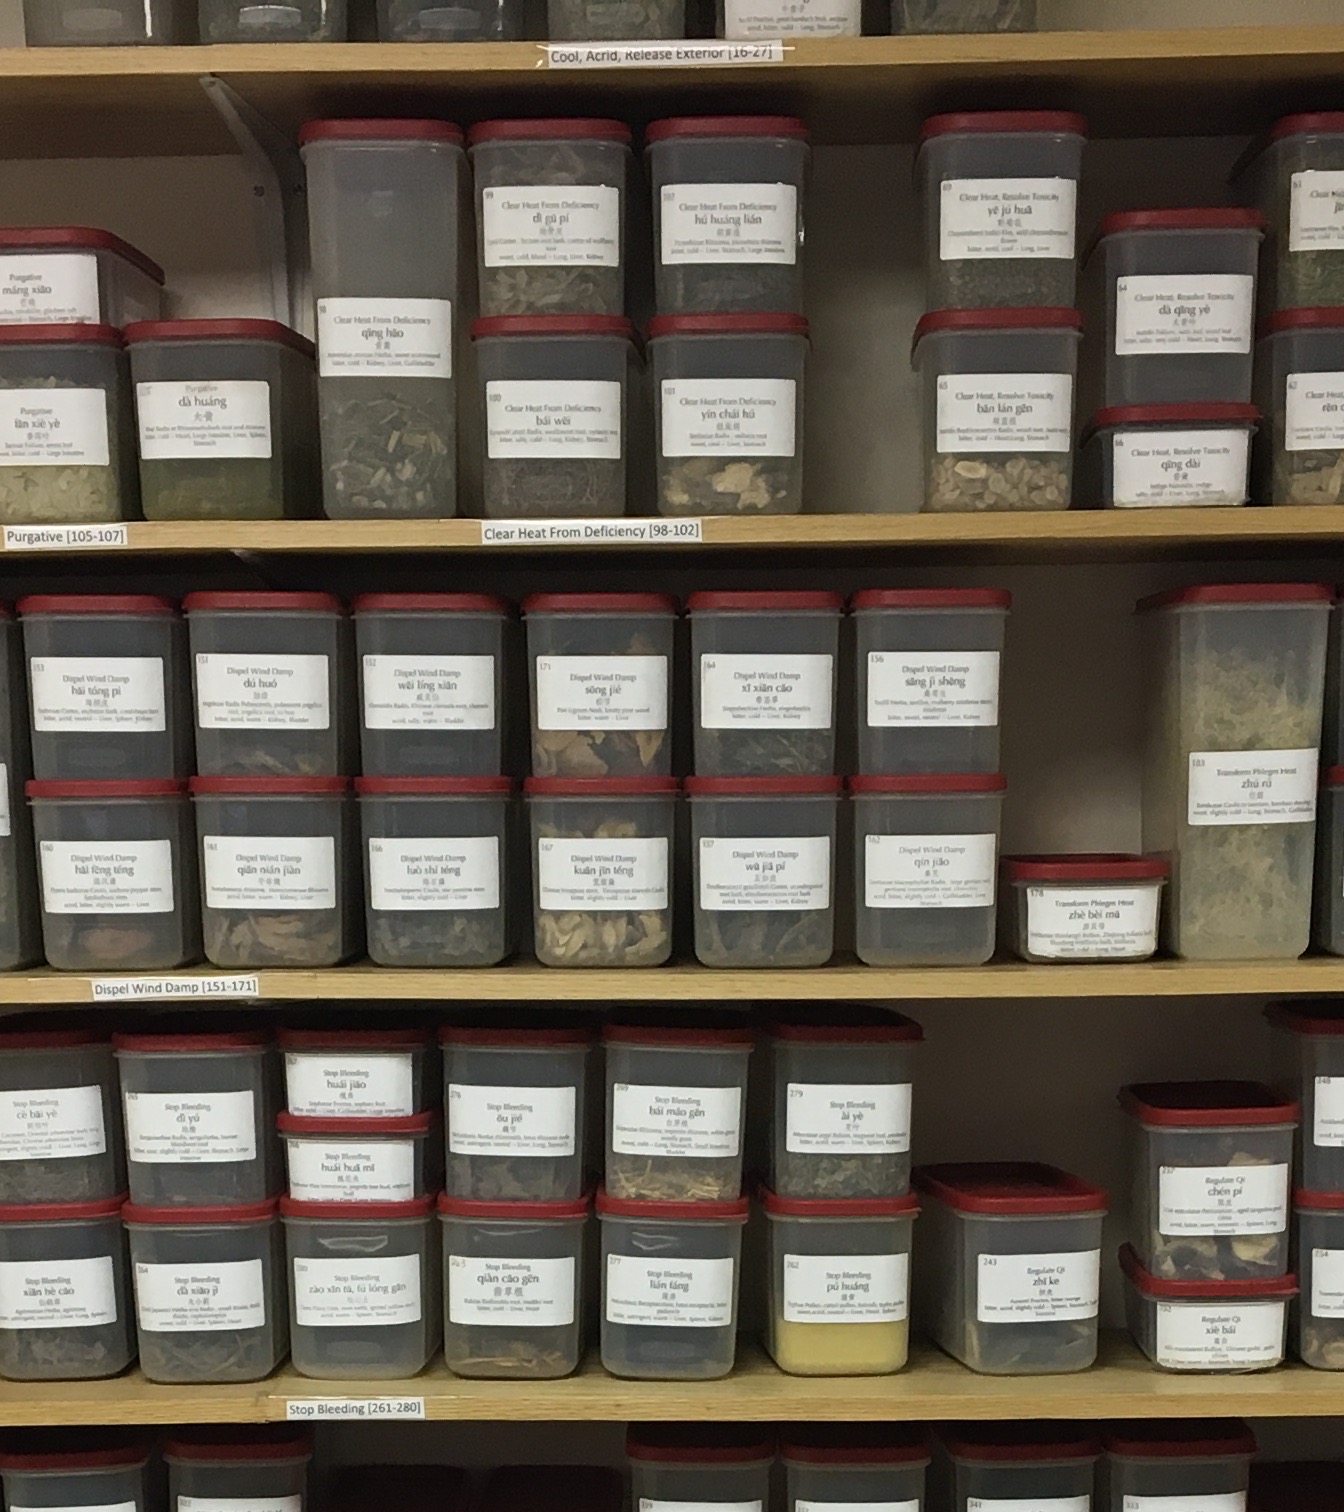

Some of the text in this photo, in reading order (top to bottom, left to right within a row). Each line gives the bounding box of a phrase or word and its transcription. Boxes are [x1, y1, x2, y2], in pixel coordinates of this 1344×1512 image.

[551, 51, 582, 64] Cool,
[586, 50, 621, 63] Acrid,
[625, 47, 673, 61] Release
[676, 47, 725, 60] Exterior
[7, 530, 124, 545] Purgative [105-107]
[484, 524, 700, 540] Clear Heat From Deficiency [98-102]
[95, 980, 256, 996] Dispel Wind Damp [151-171]
[984, 1258, 997, 1266] 243
[289, 1401, 420, 1417] Stop Bleeding [261-280]
